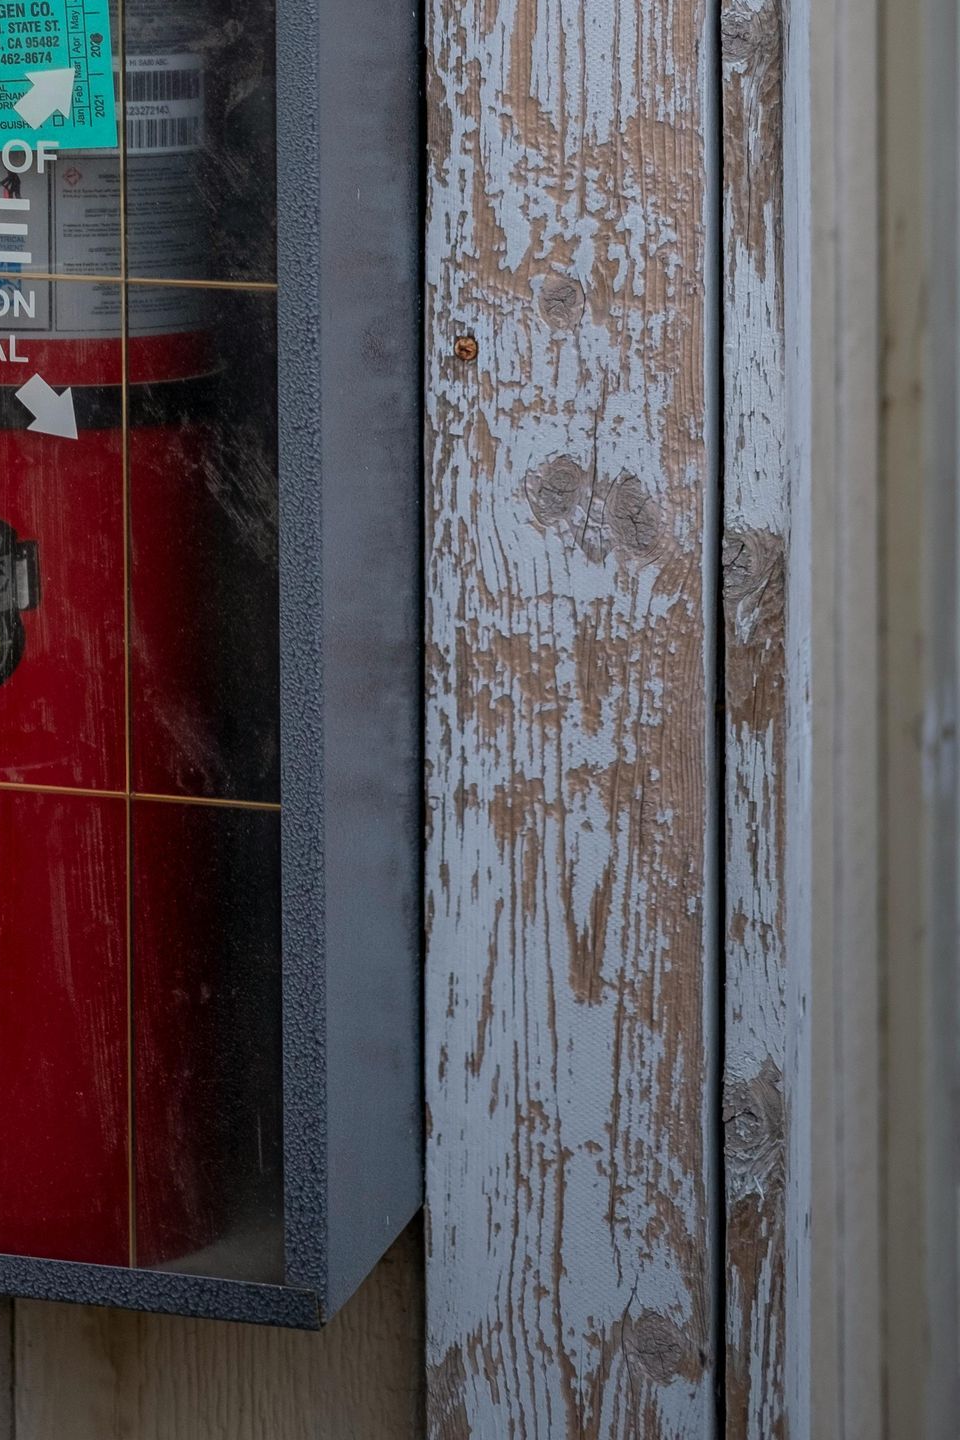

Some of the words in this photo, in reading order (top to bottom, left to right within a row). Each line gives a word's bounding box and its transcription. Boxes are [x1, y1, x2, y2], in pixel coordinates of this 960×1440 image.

[30, 1, 54, 17] CO.
[8, 21, 41, 34] STATE
[44, 20, 60, 32] ST.
[70, 11, 80, 29] May
[7, 37, 22, 50] CA
[26, 36, 60, 48] 95482
[72, 37, 81, 53] Apr
[74, 61, 82, 78] Mar
[75, 85, 84, 104] Feb
[95, 94, 106, 118] 2021
[77, 107, 85, 126] Jan
[2, 139, 59, 174] OF
